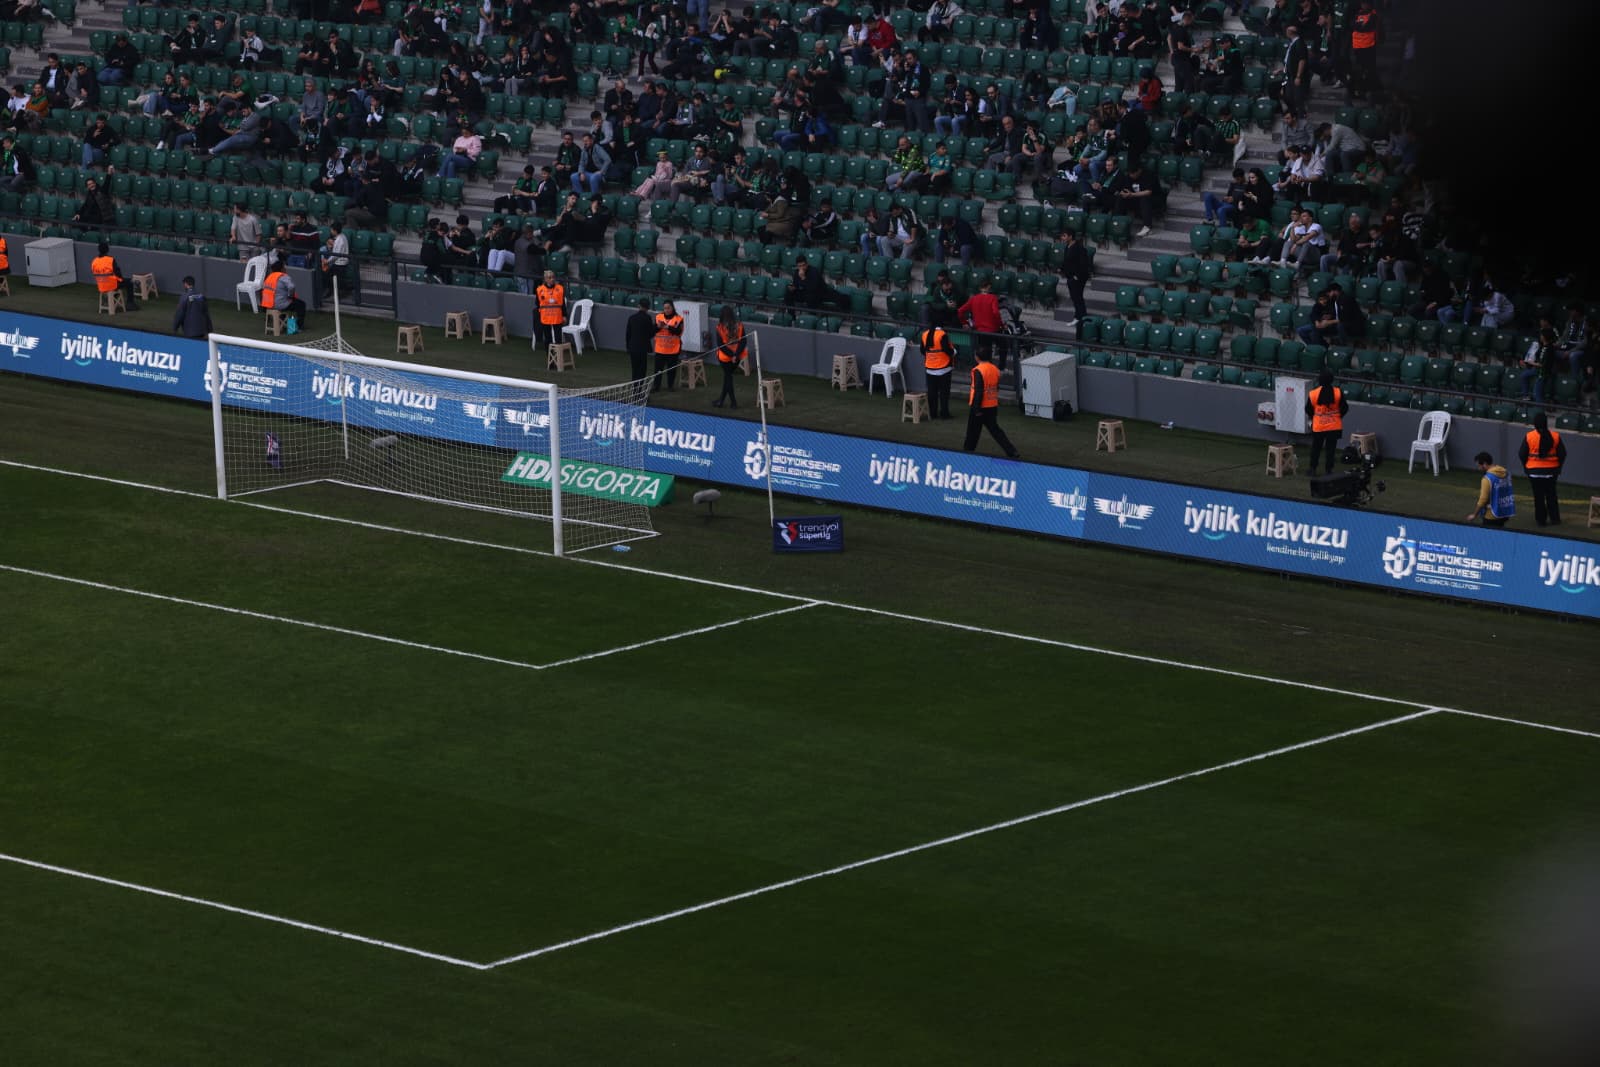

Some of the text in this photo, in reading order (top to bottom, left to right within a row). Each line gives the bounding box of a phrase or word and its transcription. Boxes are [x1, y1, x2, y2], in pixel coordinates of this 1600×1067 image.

[61, 332, 102, 360] iyilik
[106, 339, 181, 371] kılavuzu
[359, 378, 437, 410] kılavuzu
[580, 410, 625, 440] iyilik
[630, 417, 715, 453] kılavuzu
[869, 453, 1017, 499] iyilik kılavuzu
[799, 522, 839, 533] trendyol
[1184, 500, 1349, 549] iyilik kılavuzu
[1539, 551, 1600, 586] iyilik
